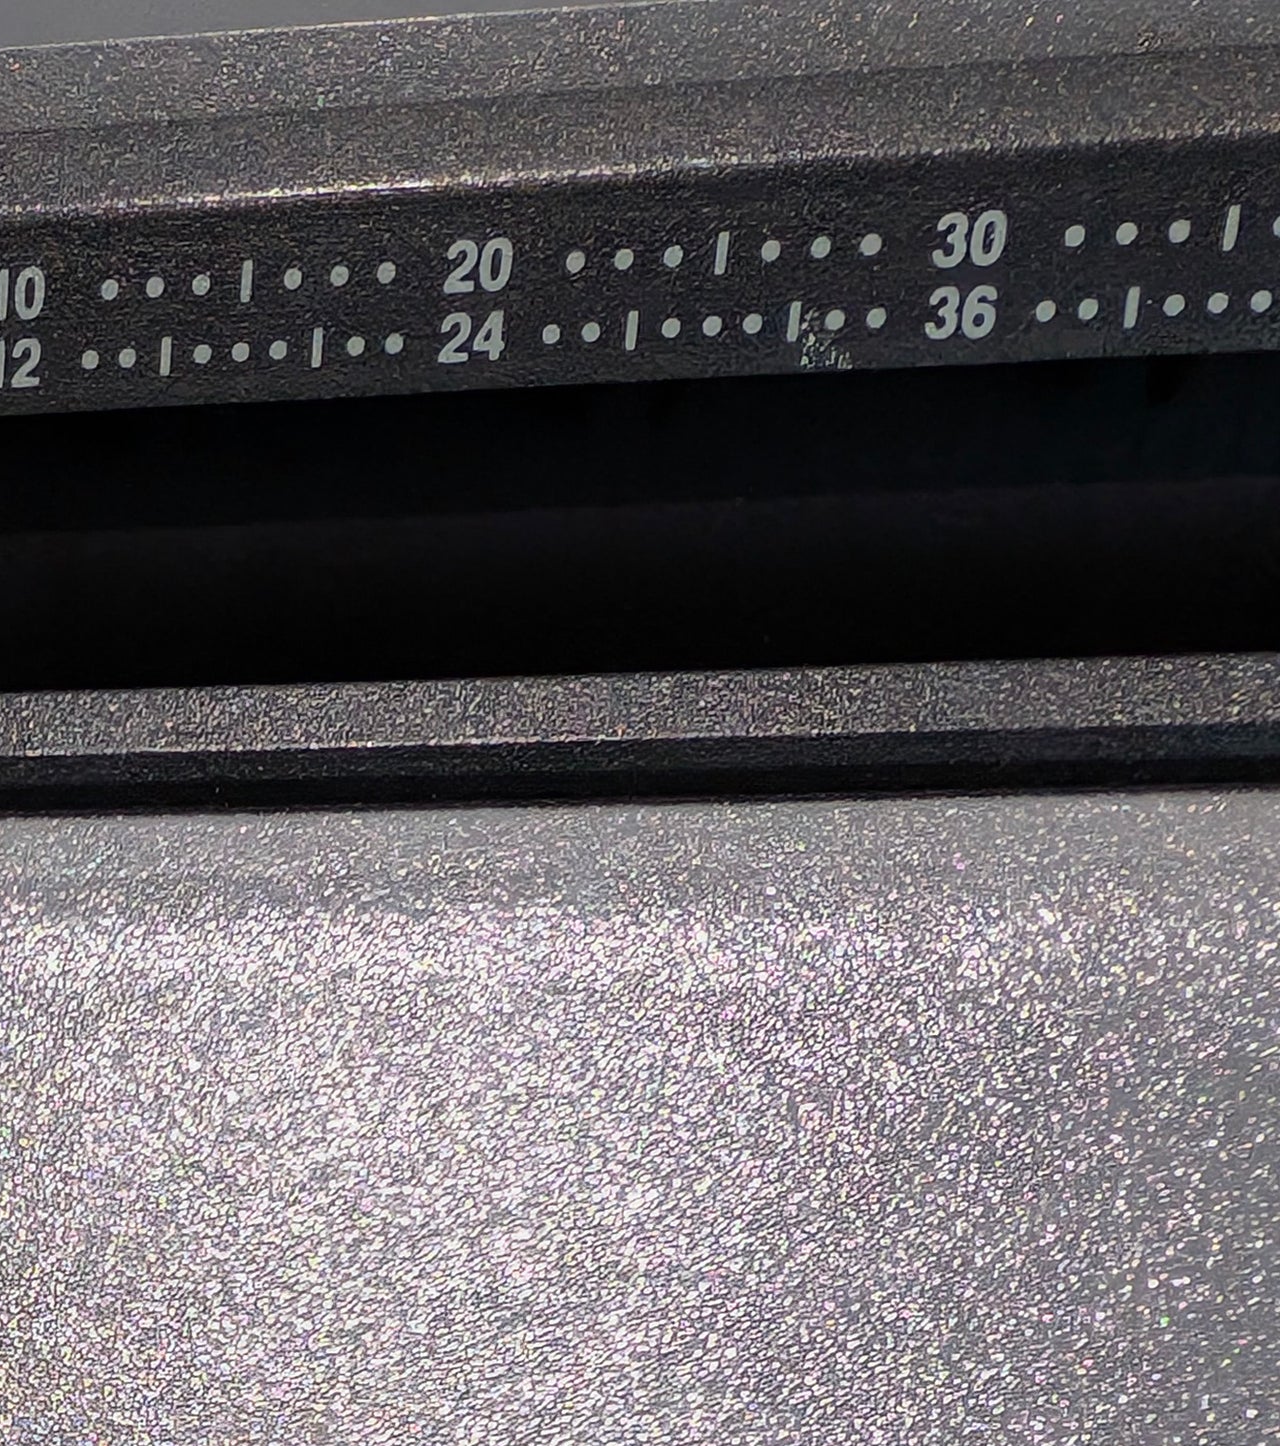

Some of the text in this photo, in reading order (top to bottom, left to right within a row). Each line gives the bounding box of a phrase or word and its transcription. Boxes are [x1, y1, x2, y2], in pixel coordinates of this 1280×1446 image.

[442, 236, 514, 294] 20
[931, 209, 1008, 269] 30
[437, 310, 505, 364] 24
[924, 284, 998, 340] 36
